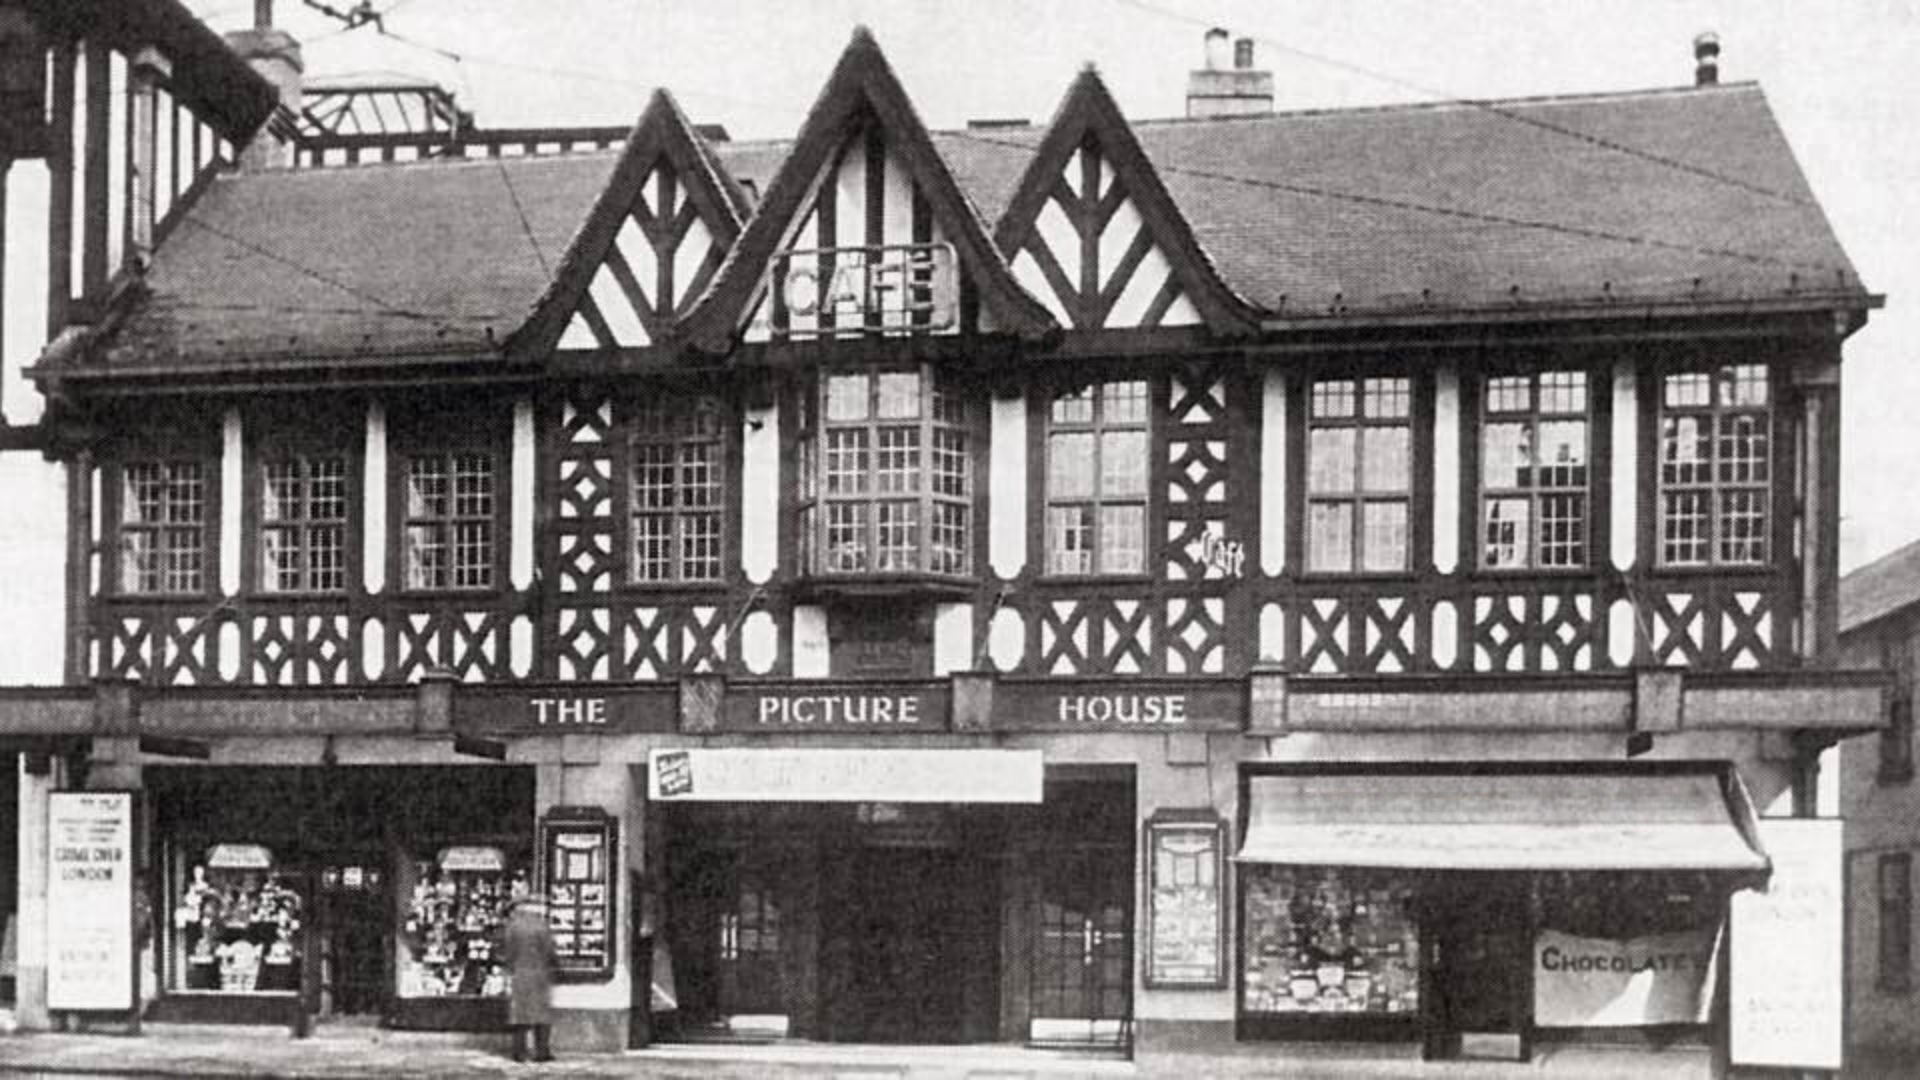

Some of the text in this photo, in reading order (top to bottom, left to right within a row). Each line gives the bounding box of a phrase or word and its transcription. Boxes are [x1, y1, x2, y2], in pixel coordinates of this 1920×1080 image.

[530, 695, 1187, 724] THE PICTURE HOUSE
